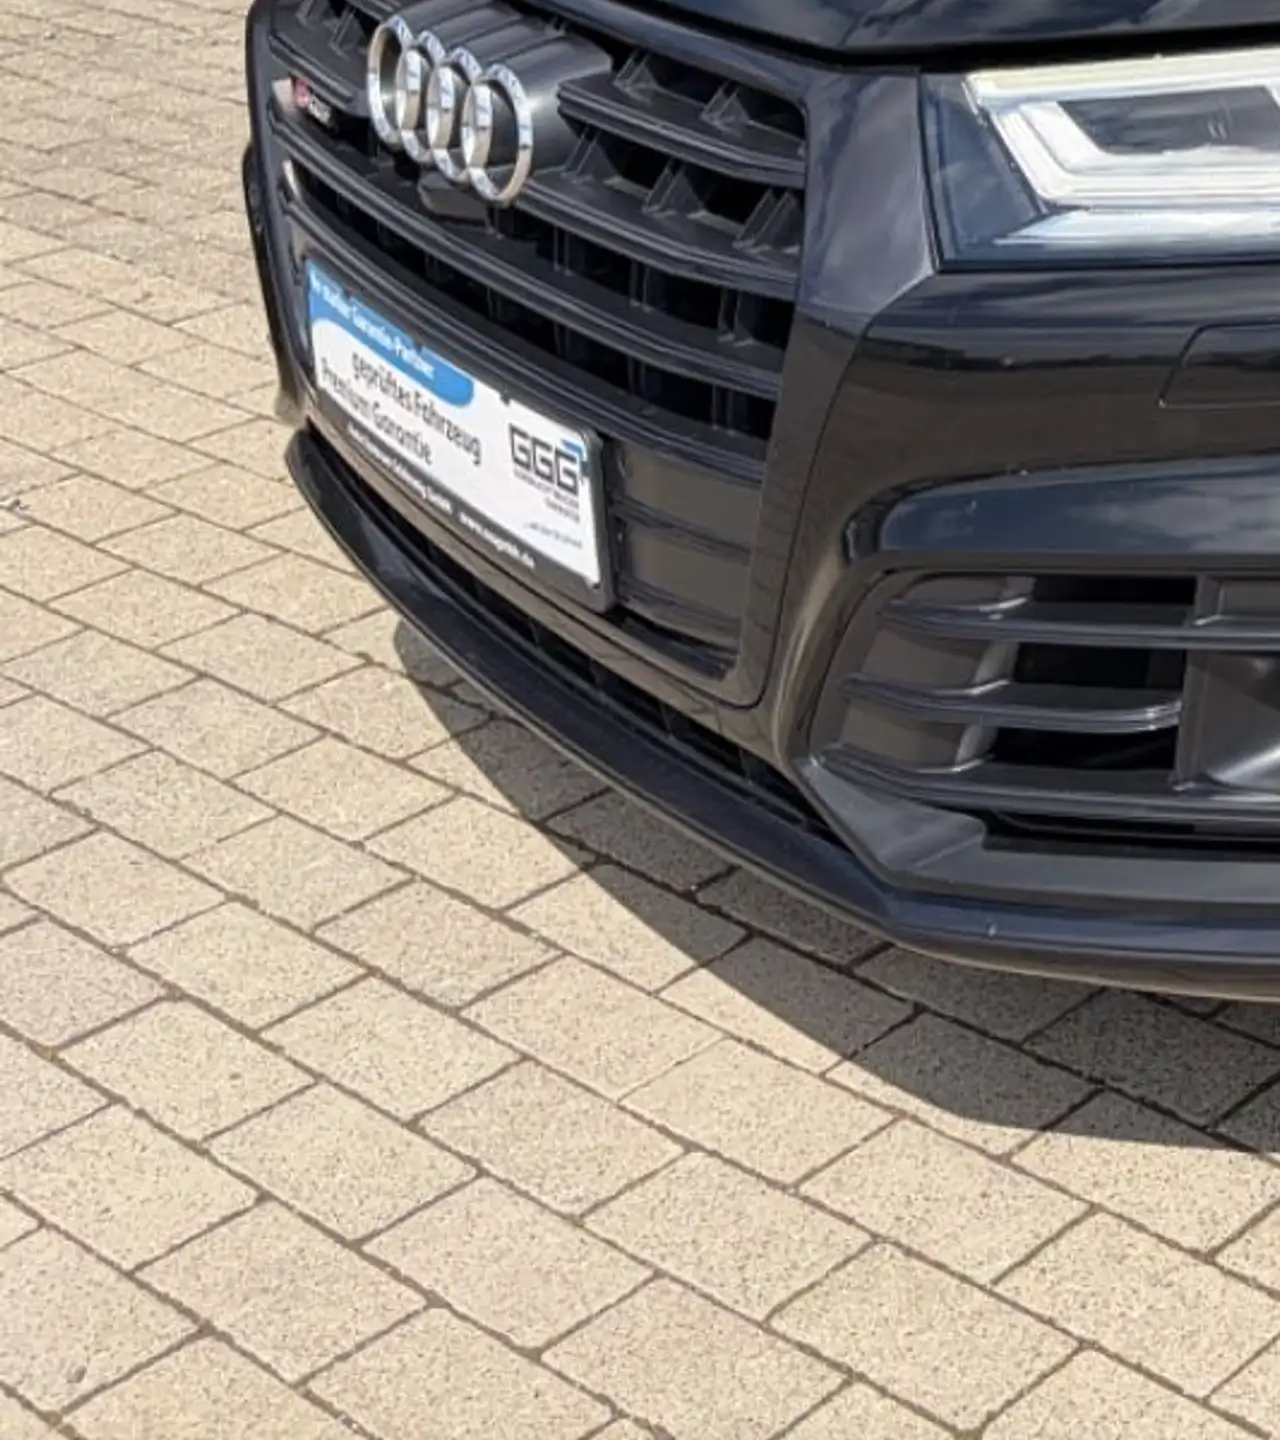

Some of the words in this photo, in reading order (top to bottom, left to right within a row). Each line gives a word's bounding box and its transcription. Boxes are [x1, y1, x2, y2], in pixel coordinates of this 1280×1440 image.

[372, 400, 432, 466] Garantie
[414, 390, 482, 466] Fahrzeug
[509, 422, 580, 498] GGG
